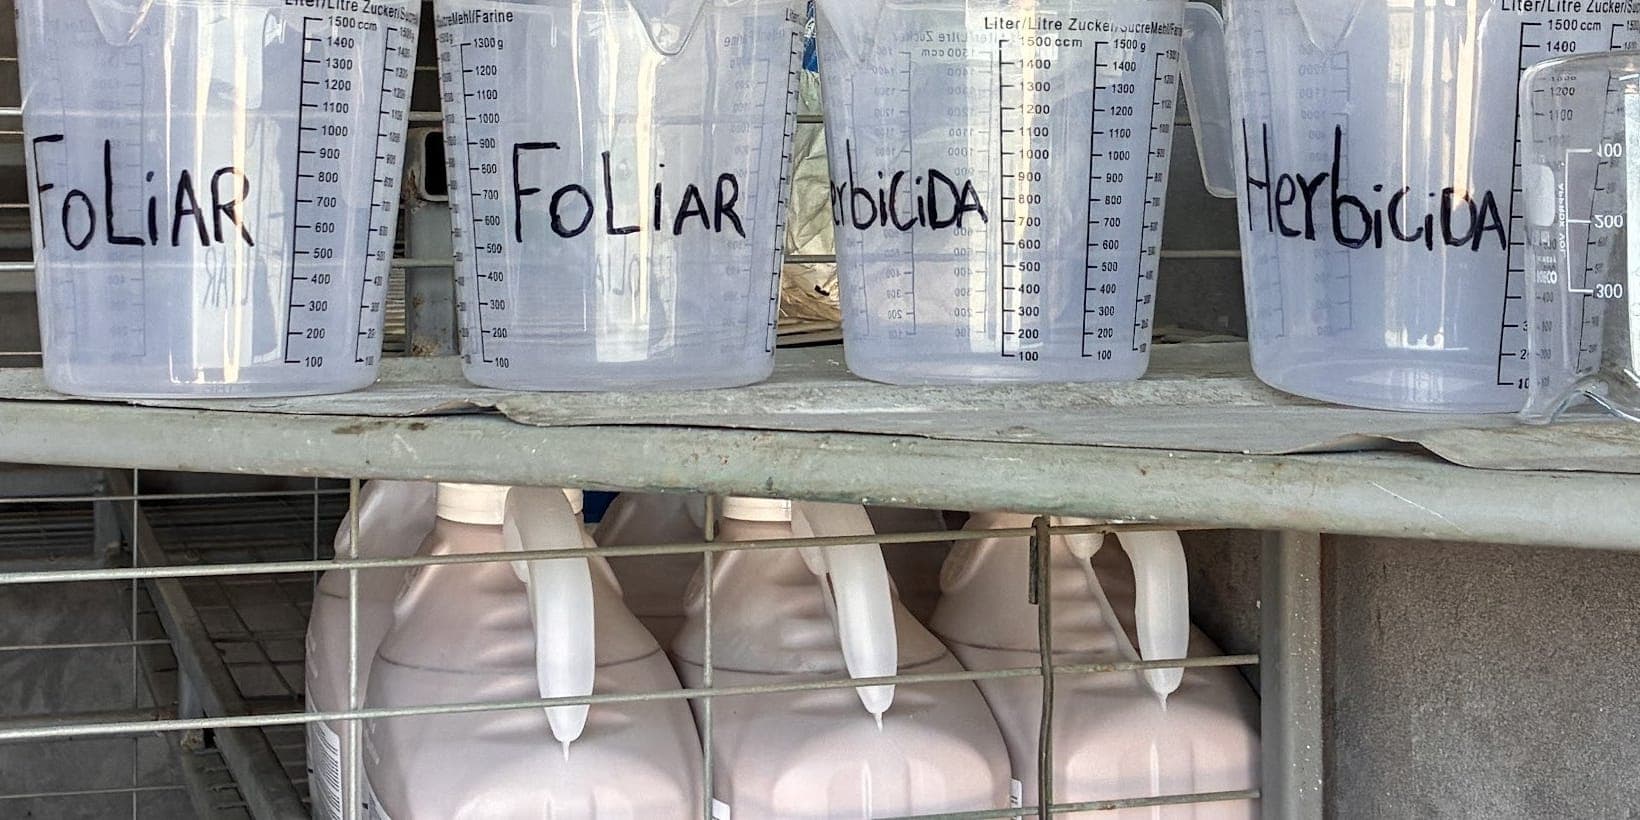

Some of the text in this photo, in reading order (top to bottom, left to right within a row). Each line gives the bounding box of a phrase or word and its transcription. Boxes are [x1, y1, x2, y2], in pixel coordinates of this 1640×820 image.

[1501, 0, 1581, 12] Liter/Litre
[328, 16, 377, 31] 1500 ccm
[984, 17, 1062, 31] Liter/Litre
[1548, 19, 1601, 31] 1500 ccm
[327, 36, 355, 49] 1400
[498, 40, 504, 50] g
[1019, 37, 1083, 48] 1500 ccm
[1113, 39, 1146, 52] 1500 g
[1547, 41, 1576, 52] 1400
[325, 57, 353, 70] 1300
[1018, 59, 1051, 70] 1400
[1112, 61, 1136, 72] 1400
[475, 65, 497, 76] 1200
[324, 79, 351, 91] 1200
[1018, 81, 1051, 92] 1300
[1111, 83, 1135, 94] 1300
[476, 90, 498, 100] 1100
[1550, 87, 1576, 96] 1200
[322, 101, 349, 114] 1100
[1018, 104, 1050, 115] 1200
[1110, 105, 1133, 116] 1200
[478, 113, 500, 124] 1000
[321, 125, 348, 137] 1000
[1018, 127, 1049, 137] 1100
[1109, 128, 1131, 138] 1100
[479, 138, 496, 149] 900
[319, 148, 340, 160] 900
[1018, 149, 1050, 160] 1000
[1108, 150, 1130, 161] 1000
[481, 163, 497, 174] 800
[318, 172, 338, 183] 800
[1018, 171, 1041, 182] 900
[1105, 172, 1123, 183] 900
[483, 190, 499, 200] 700
[1018, 193, 1041, 205] 800
[1104, 195, 1122, 205] 800
[317, 196, 337, 208] 700
[485, 215, 500, 226] 600
[1018, 216, 1041, 227] 700
[1103, 217, 1121, 228] 700
[315, 222, 335, 233] 600
[487, 243, 502, 254] 500
[1018, 238, 1041, 250] 600
[1102, 239, 1120, 250] 600
[313, 248, 333, 259] 500
[1018, 261, 1041, 272] 500
[1101, 261, 1118, 272] 500
[311, 274, 331, 285] 400
[487, 271, 504, 282] 400
[1018, 283, 1040, 294] 400
[1099, 283, 1116, 294] 400
[309, 300, 328, 312] 300
[490, 300, 506, 310] 300
[1018, 306, 1040, 317] 300
[1098, 306, 1115, 316] 300
[306, 328, 325, 339] 200
[492, 327, 508, 338] 200
[1018, 328, 1039, 339] 200
[1097, 328, 1113, 339] 200
[1018, 351, 1039, 361] 100
[1097, 350, 1112, 361] 100
[305, 356, 323, 368] 100
[495, 357, 510, 368] 100
